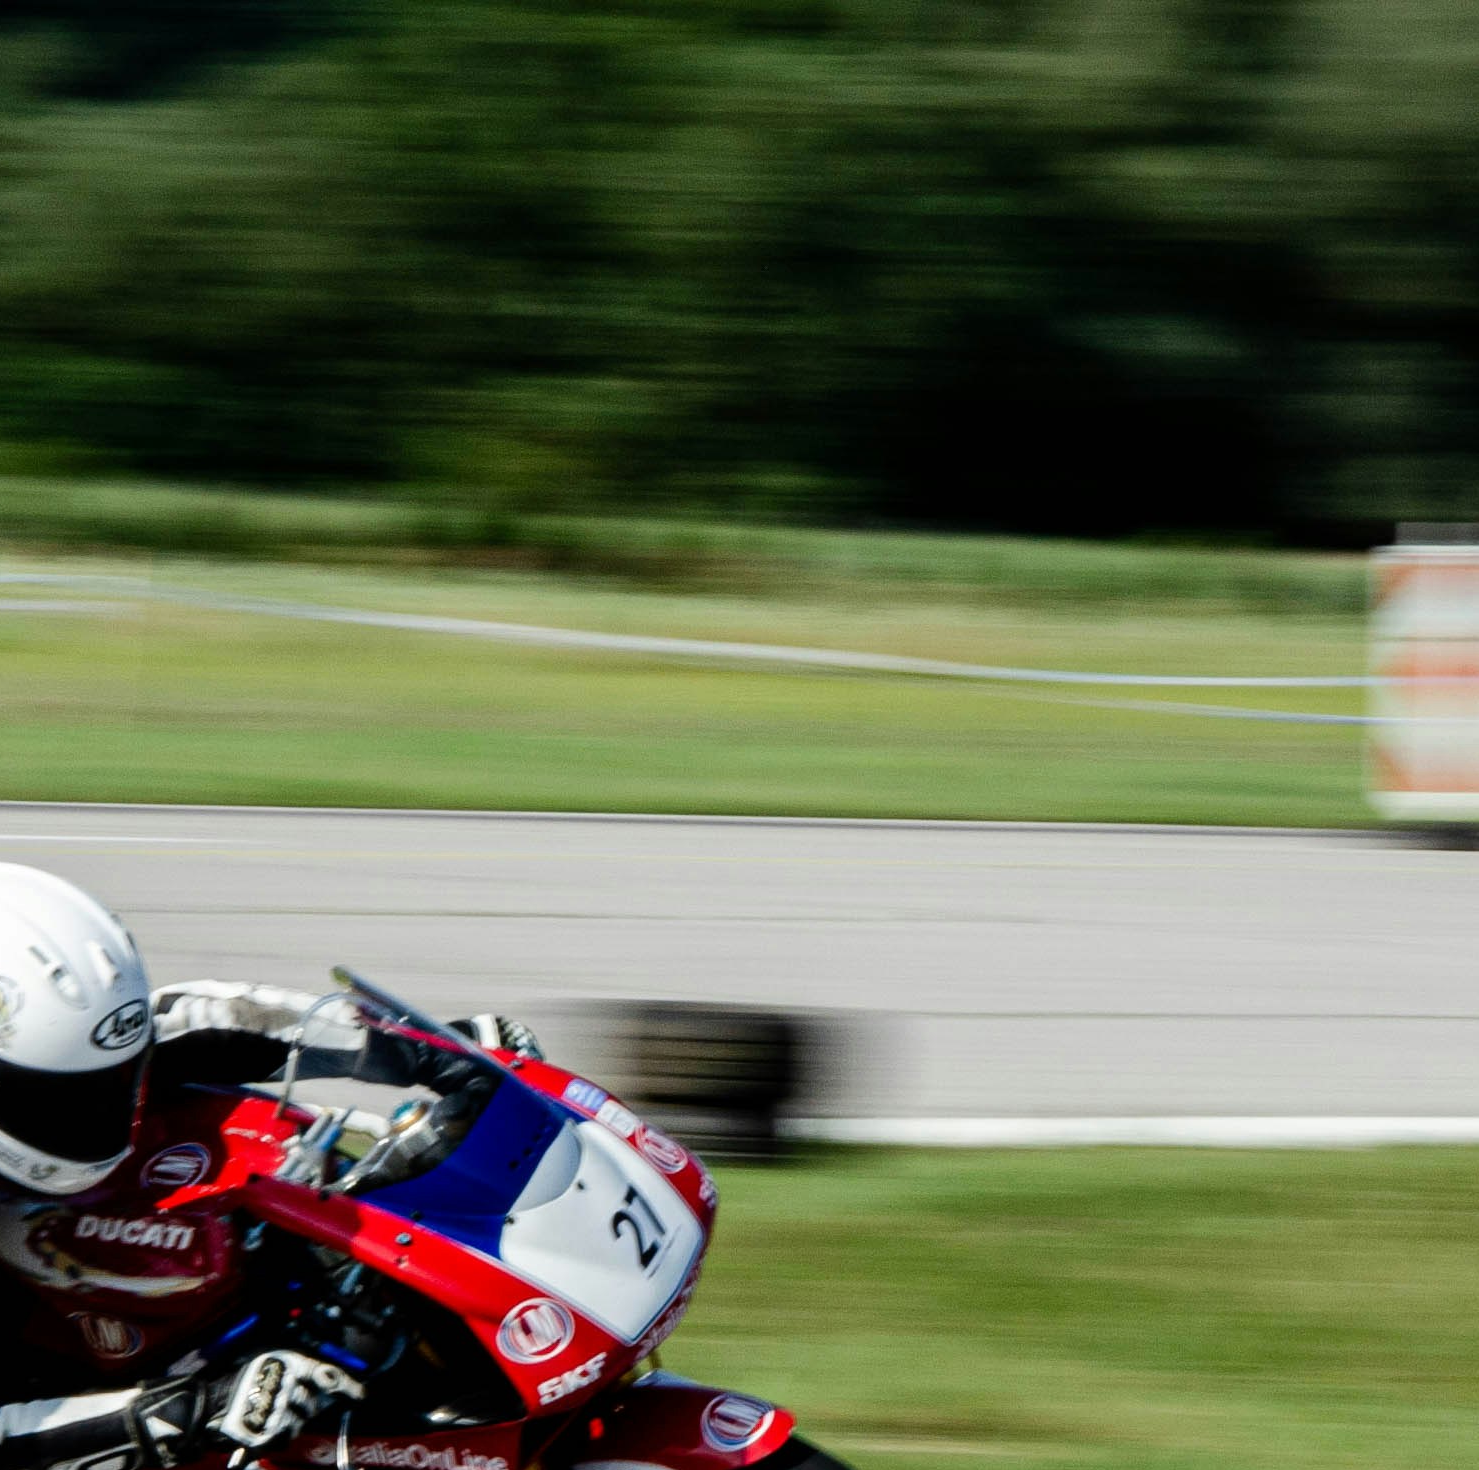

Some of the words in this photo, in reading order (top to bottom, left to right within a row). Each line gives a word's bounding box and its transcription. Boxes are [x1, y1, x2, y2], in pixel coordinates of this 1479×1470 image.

[74, 1215, 196, 1251] DUCATI
[612, 1184, 666, 1269] 27
[537, 1351, 608, 1405] SKF
